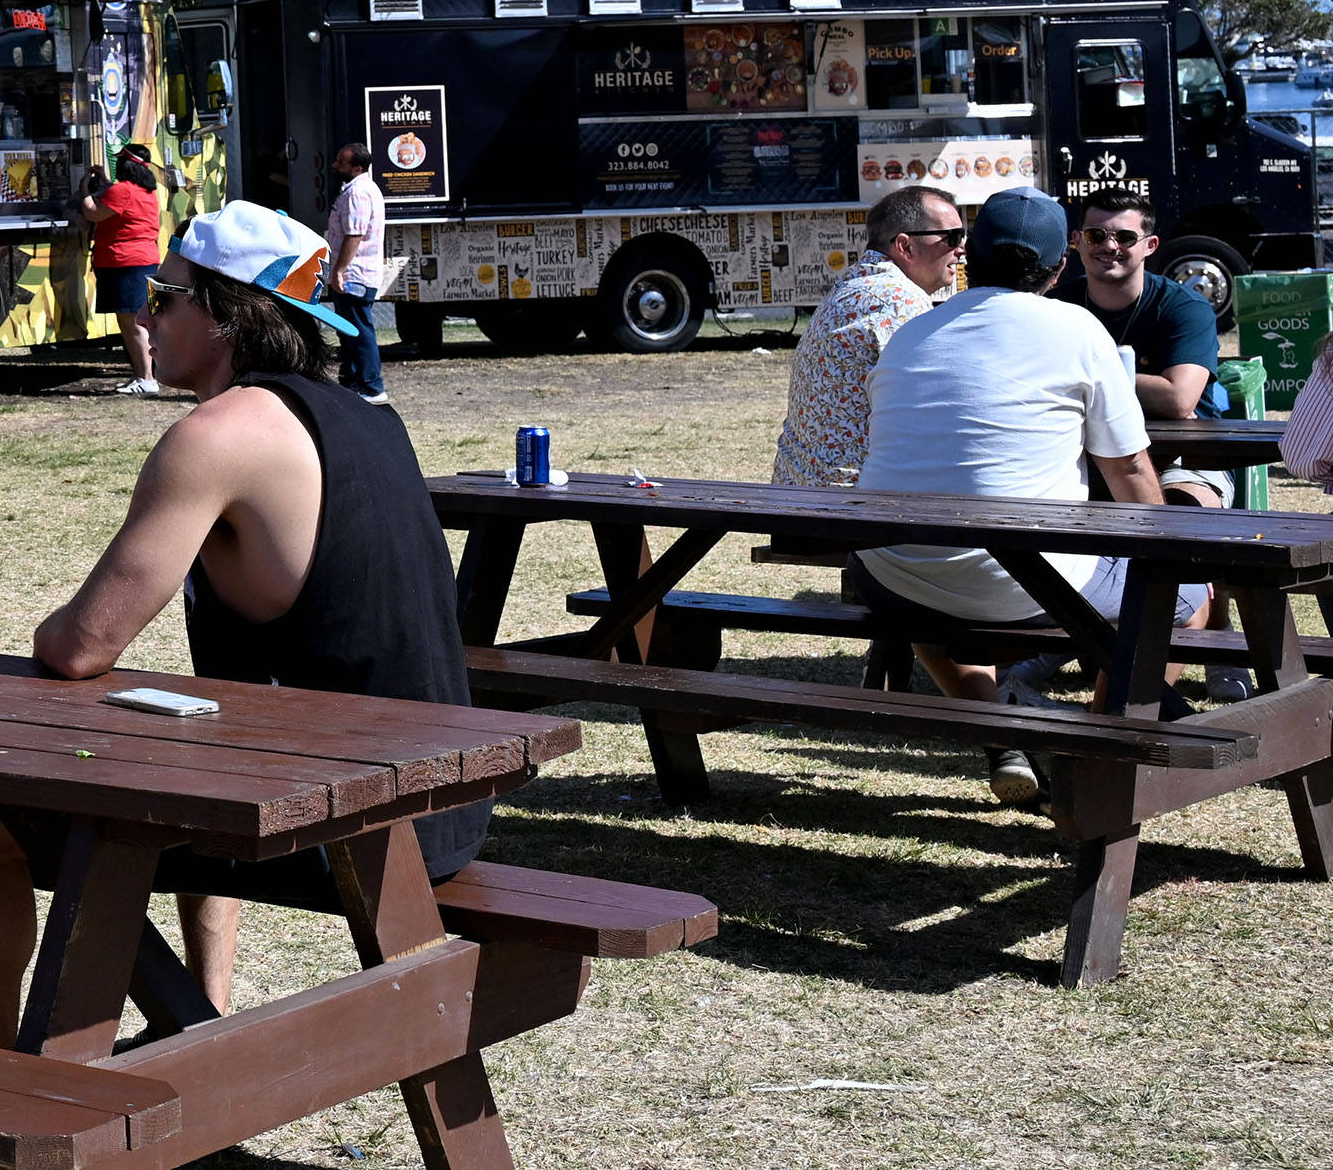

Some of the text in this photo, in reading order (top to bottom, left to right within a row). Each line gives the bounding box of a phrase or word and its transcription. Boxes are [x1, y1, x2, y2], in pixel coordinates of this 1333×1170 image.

[935, 20, 946, 31] A
[867, 46, 913, 61] Pick Up
[982, 44, 1017, 56] Order
[595, 71, 674, 87] HERITAGE
[380, 111, 432, 122] HERITAGE
[607, 161, 670, 171] 323.884.8042
[791, 210, 843, 222] Los Angeles
[499, 223, 534, 237] BURGER
[554, 228, 575, 238] MAYO
[818, 232, 844, 240] Organic
[535, 234, 553, 249] BEEF
[498, 240, 531, 258] Heritage
[706, 244, 729, 254] ONION
[536, 250, 575, 265] TURKEY
[535, 274, 556, 282] ONION
[557, 267, 576, 282] PORK
[536, 283, 576, 298] LETTUCE
[773, 289, 793, 303] BEEF
[1262, 291, 1301, 303] FOOD
[1258, 318, 1309, 330] GOODS
[1264, 379, 1307, 391] OMPO
